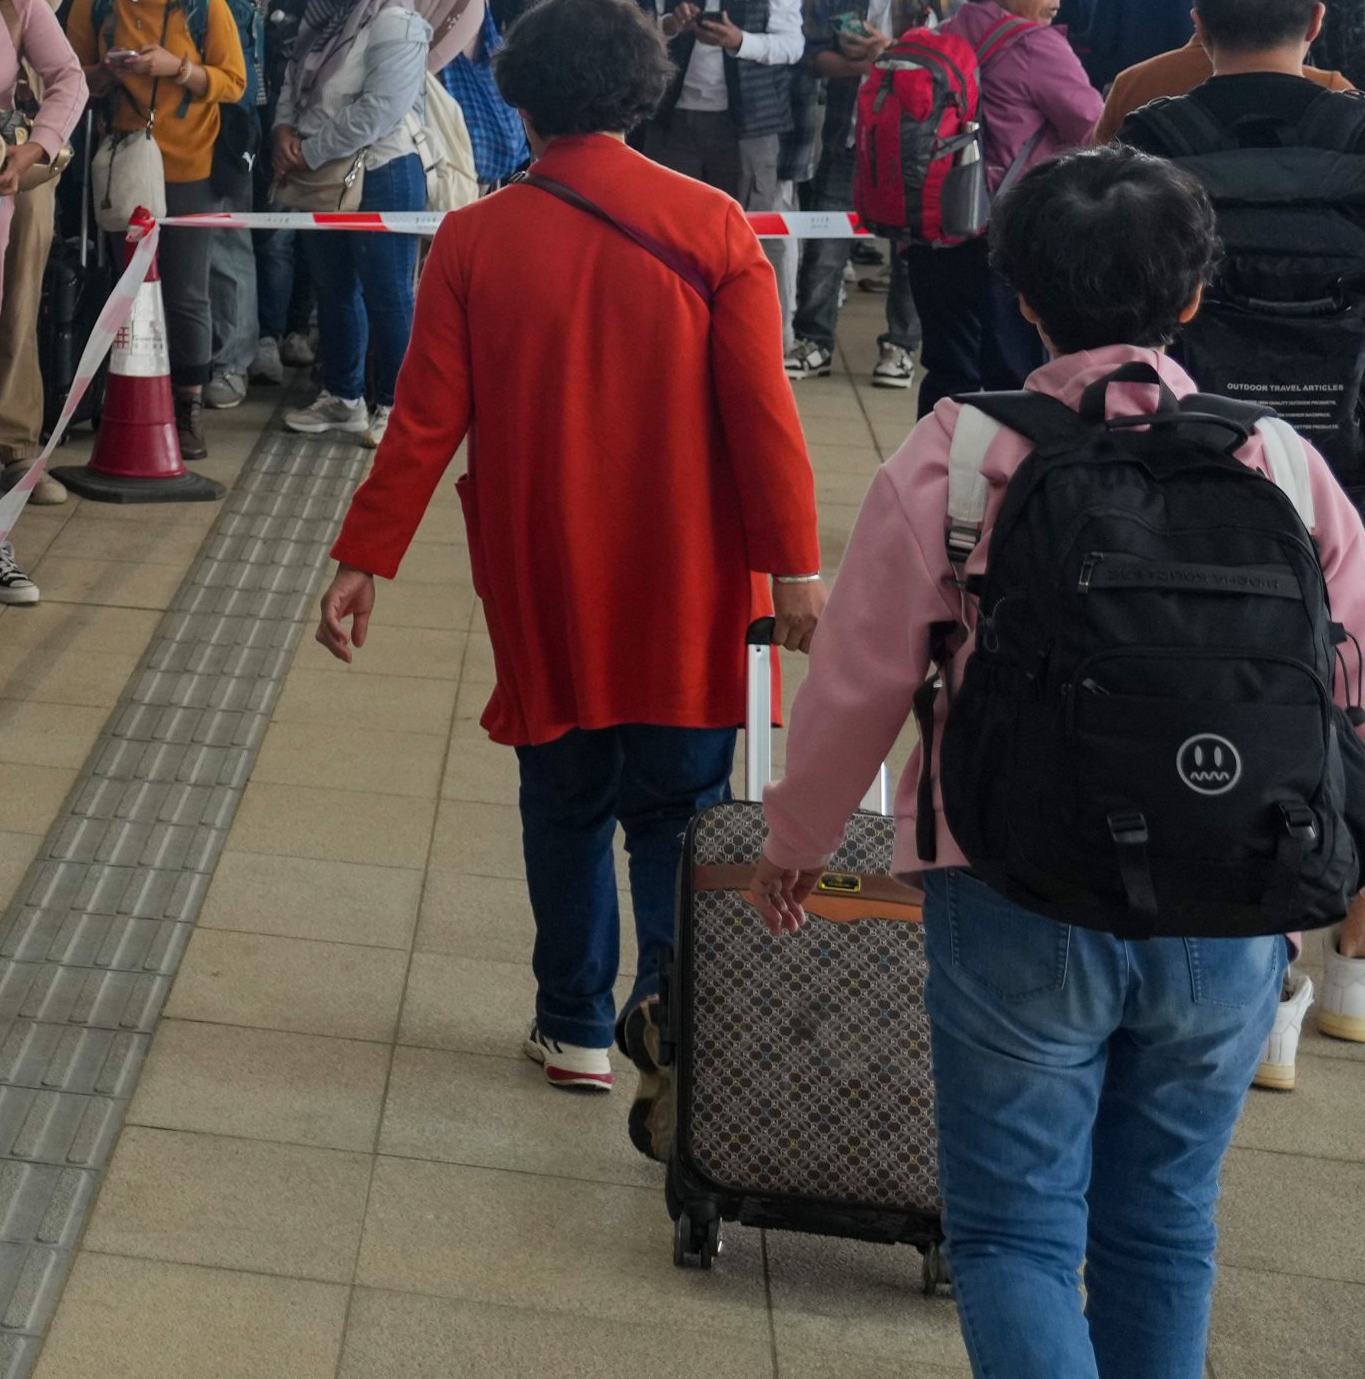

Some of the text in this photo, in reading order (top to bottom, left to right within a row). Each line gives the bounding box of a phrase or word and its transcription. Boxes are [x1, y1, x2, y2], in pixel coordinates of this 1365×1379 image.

[1227, 383, 1344, 392] OUTDOOR TRAVEL ARTICLES
